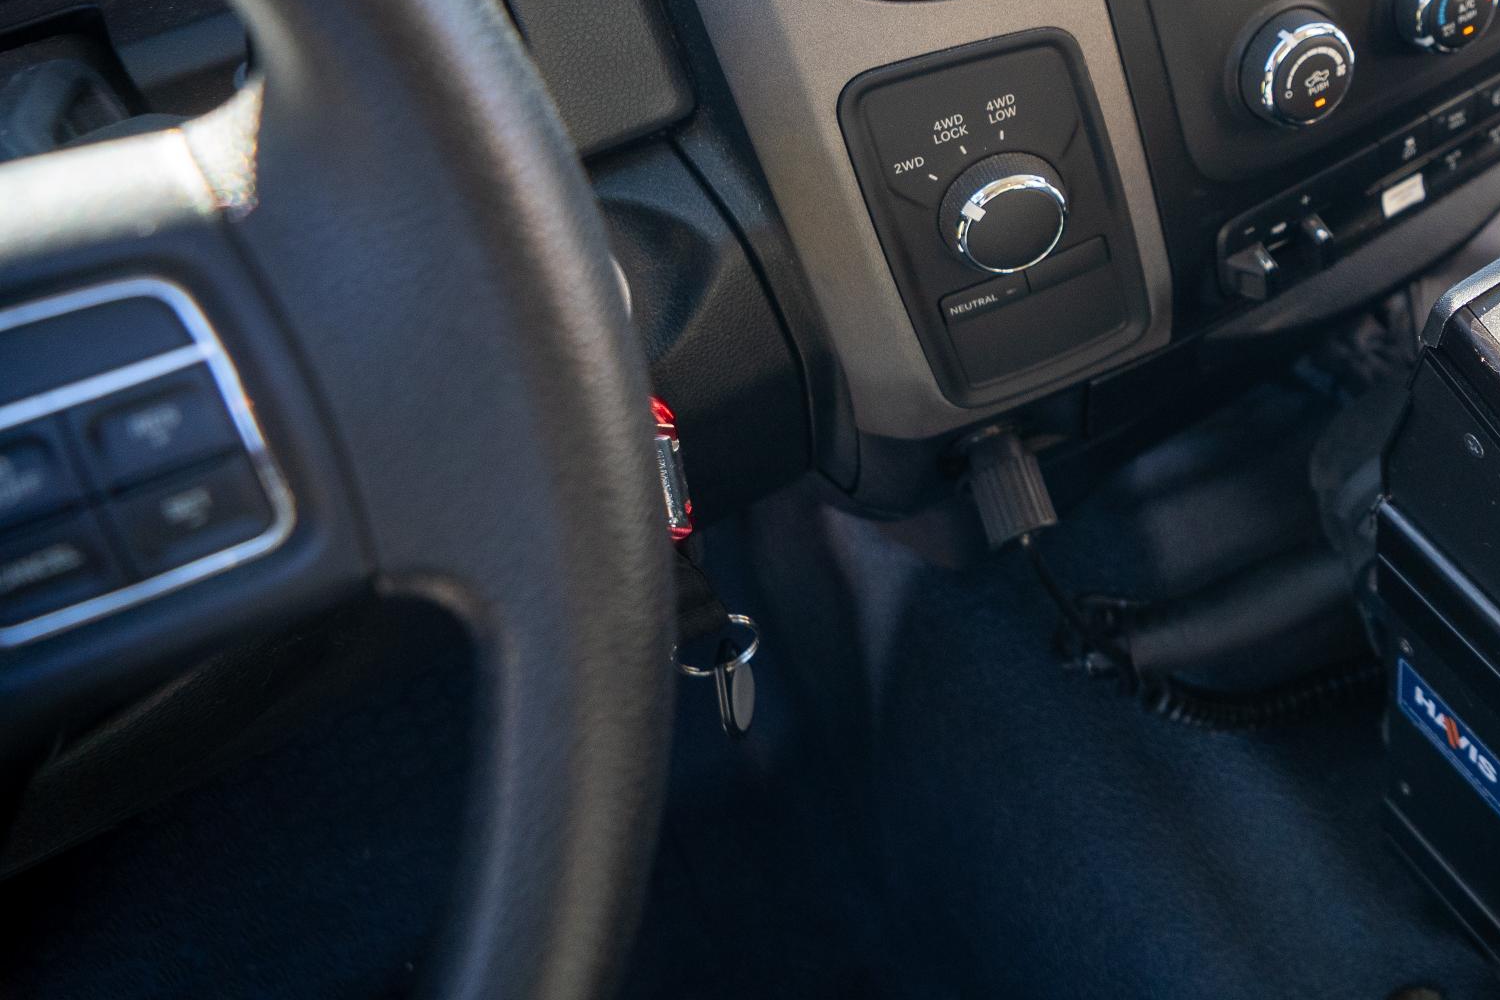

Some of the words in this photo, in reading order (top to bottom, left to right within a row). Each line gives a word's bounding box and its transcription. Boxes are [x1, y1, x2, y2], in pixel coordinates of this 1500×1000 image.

[1309, 80, 1329, 96] PUSH
[986, 93, 1015, 112] 4WD
[933, 113, 964, 132] 4WD
[988, 105, 1017, 124] LOW
[933, 124, 969, 145] LOCK
[894, 156, 925, 175] 2WD
[950, 294, 998, 316] NEUTRAL
[1414, 685, 1498, 783] HAVIS
